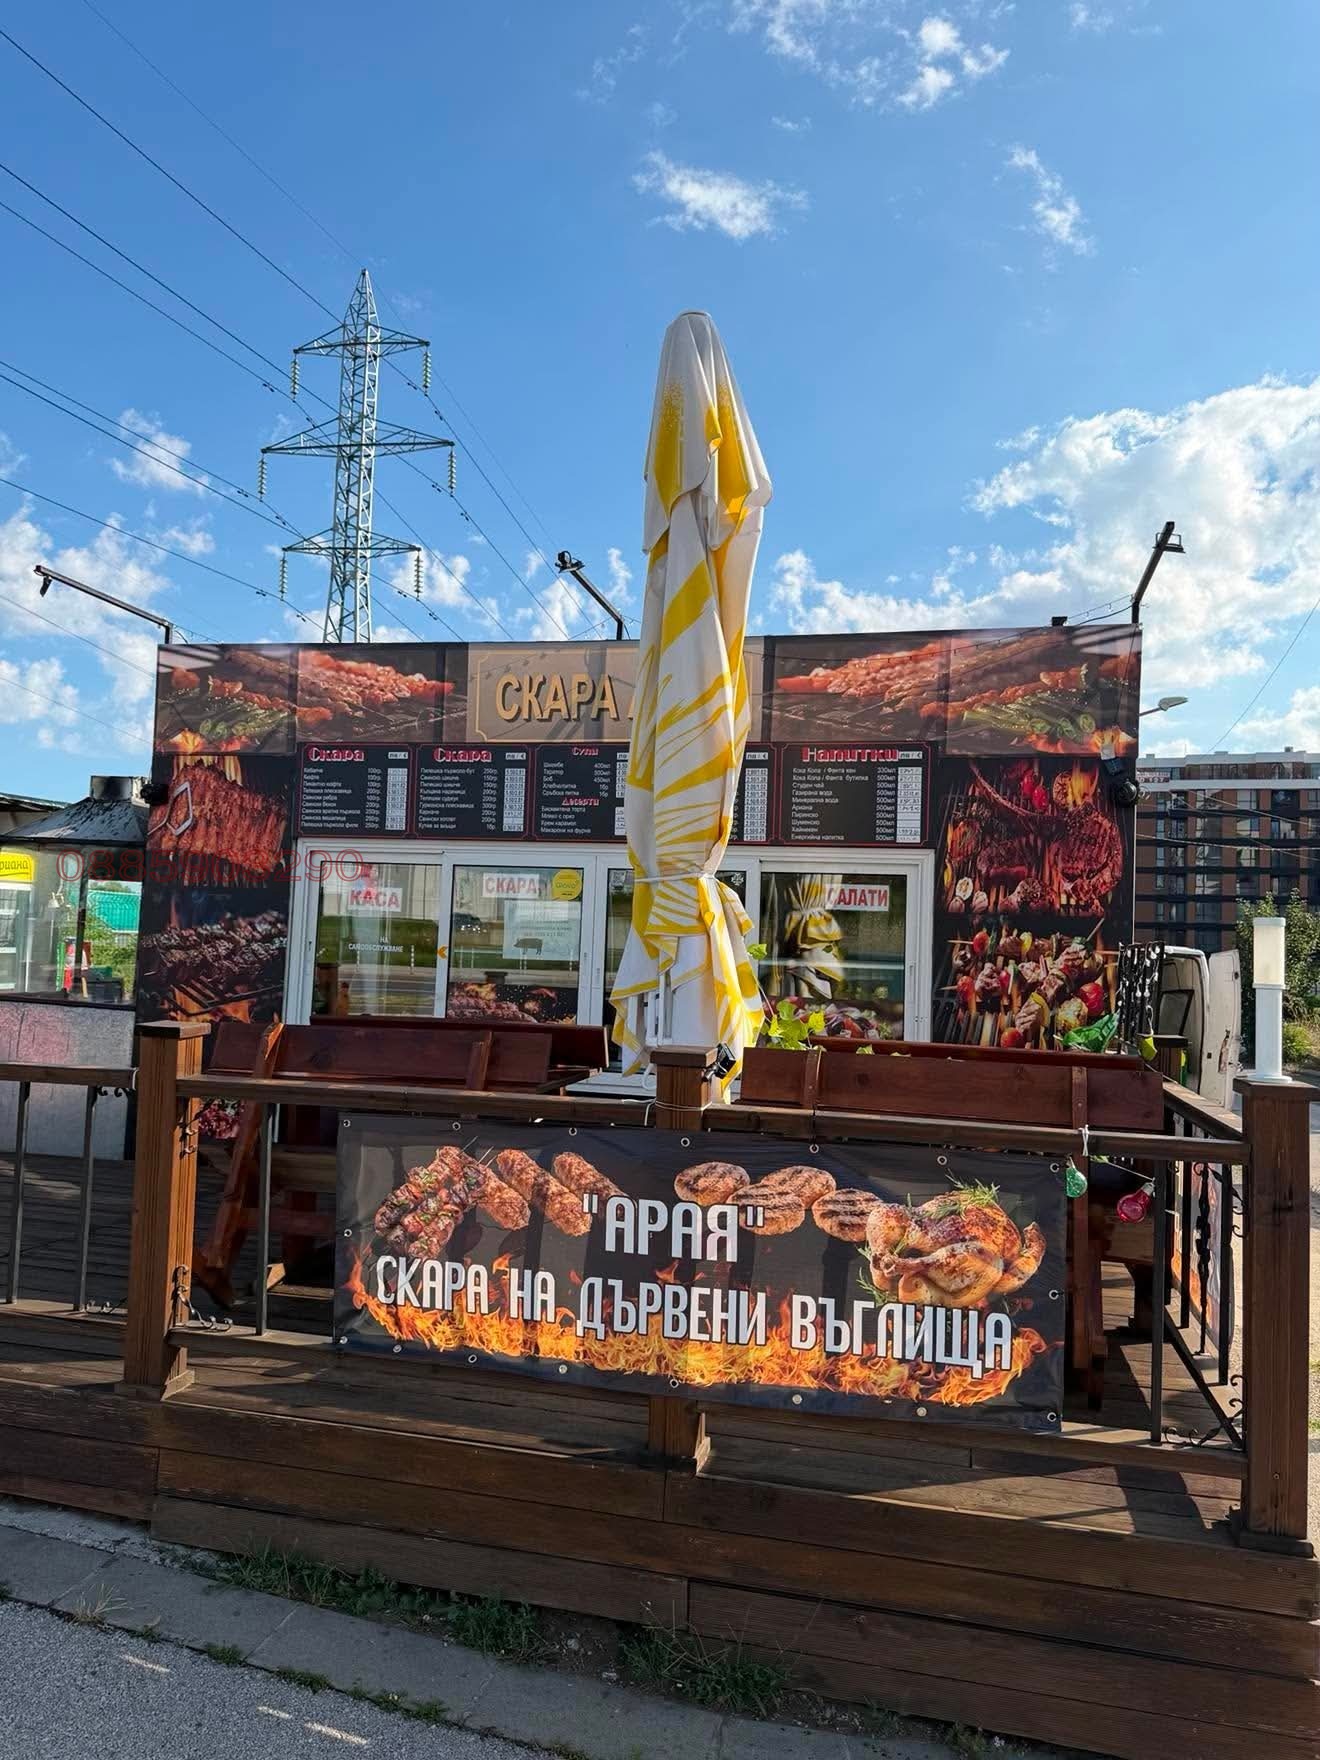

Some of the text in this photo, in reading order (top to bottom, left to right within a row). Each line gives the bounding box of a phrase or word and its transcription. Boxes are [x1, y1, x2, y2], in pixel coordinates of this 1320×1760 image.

[496, 673, 618, 722] СКАРА
[309, 747, 365, 762] Скара
[433, 748, 492, 762] Скара
[802, 746, 899, 762] Напитки
[485, 877, 537, 894] СКАРА
[350, 889, 400, 908] КАСА
[581, 1193, 765, 1264] "АРАЯ"
[375, 1254, 1012, 1379] СКАРА НА ДЪРВЕНИ ВЪГЛИЩА
